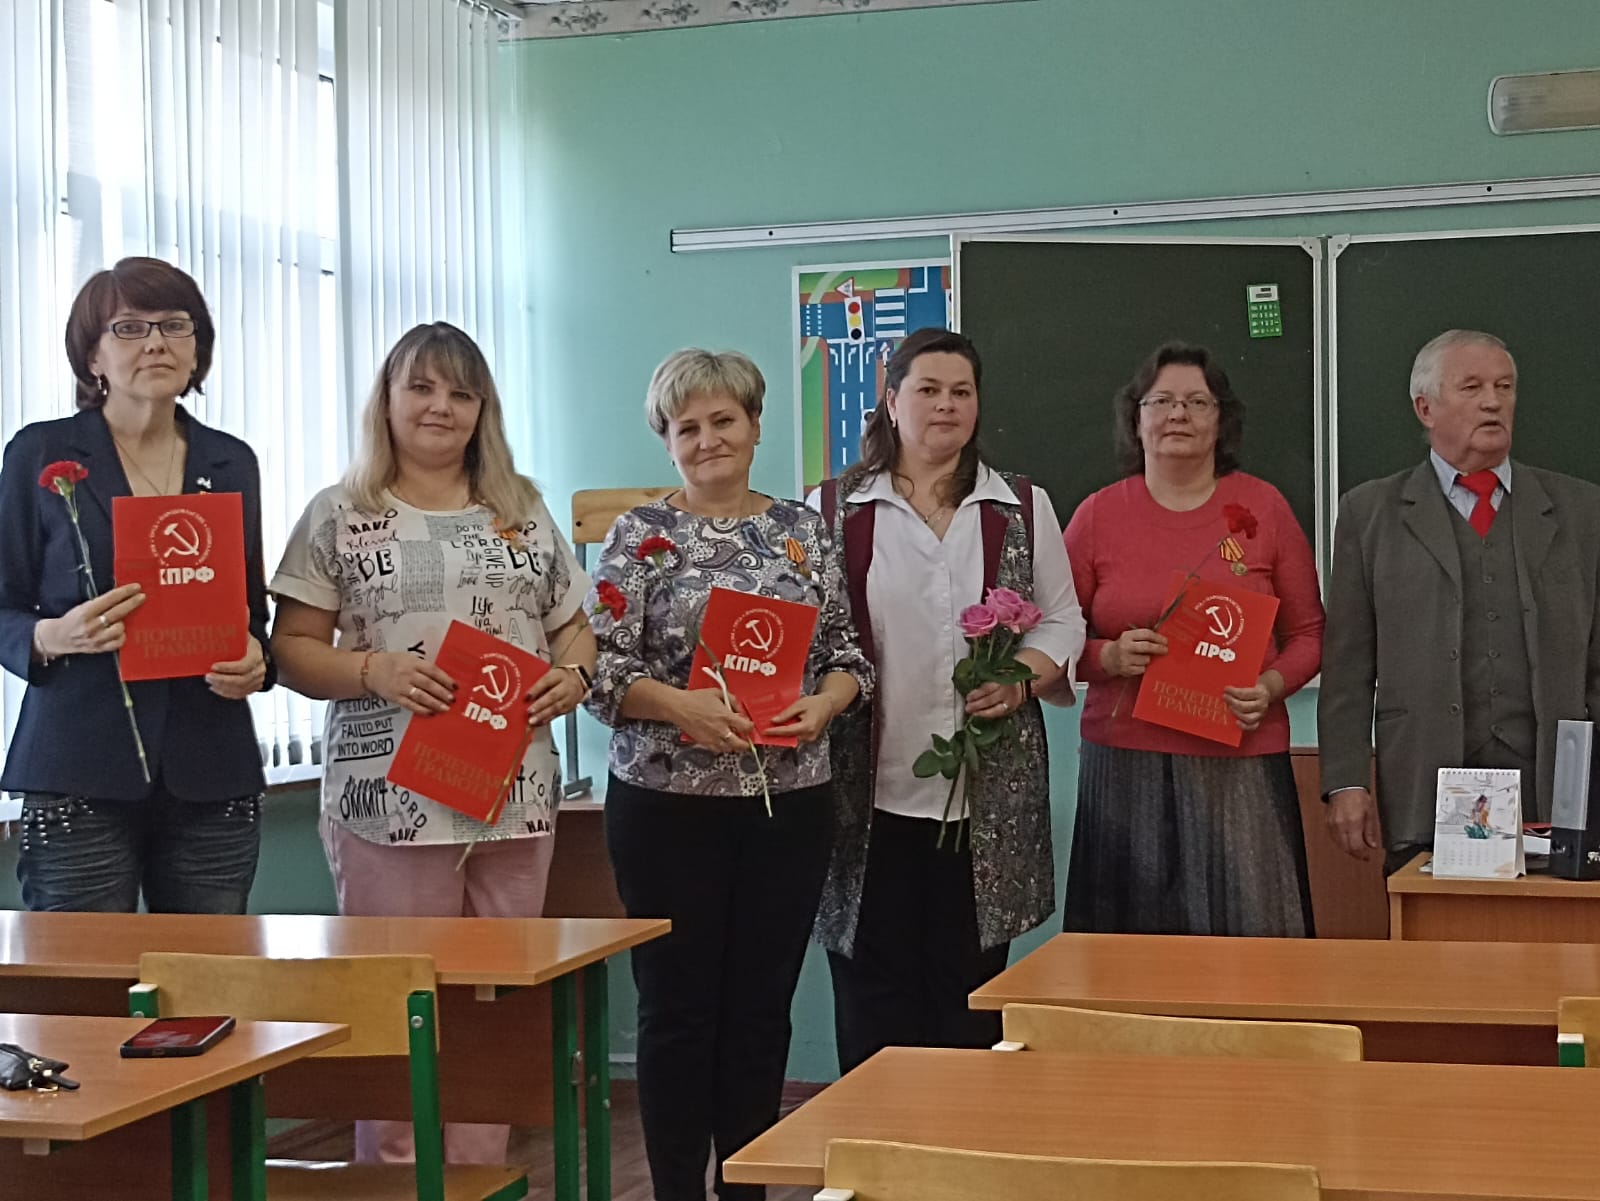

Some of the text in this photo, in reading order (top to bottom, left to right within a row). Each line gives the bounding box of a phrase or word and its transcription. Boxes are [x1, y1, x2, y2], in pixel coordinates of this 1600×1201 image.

[348, 520, 391, 535] HAVE
[472, 524, 484, 532] TO
[451, 538, 503, 549] LORD
[485, 573, 505, 588] UP
[723, 653, 777, 677] КПРФ
[1152, 679, 1229, 712] ПОЧЕТНА
[361, 722, 374, 732] TO
[374, 716, 392, 730] PUT
[338, 738, 394, 757] INTO WORD
